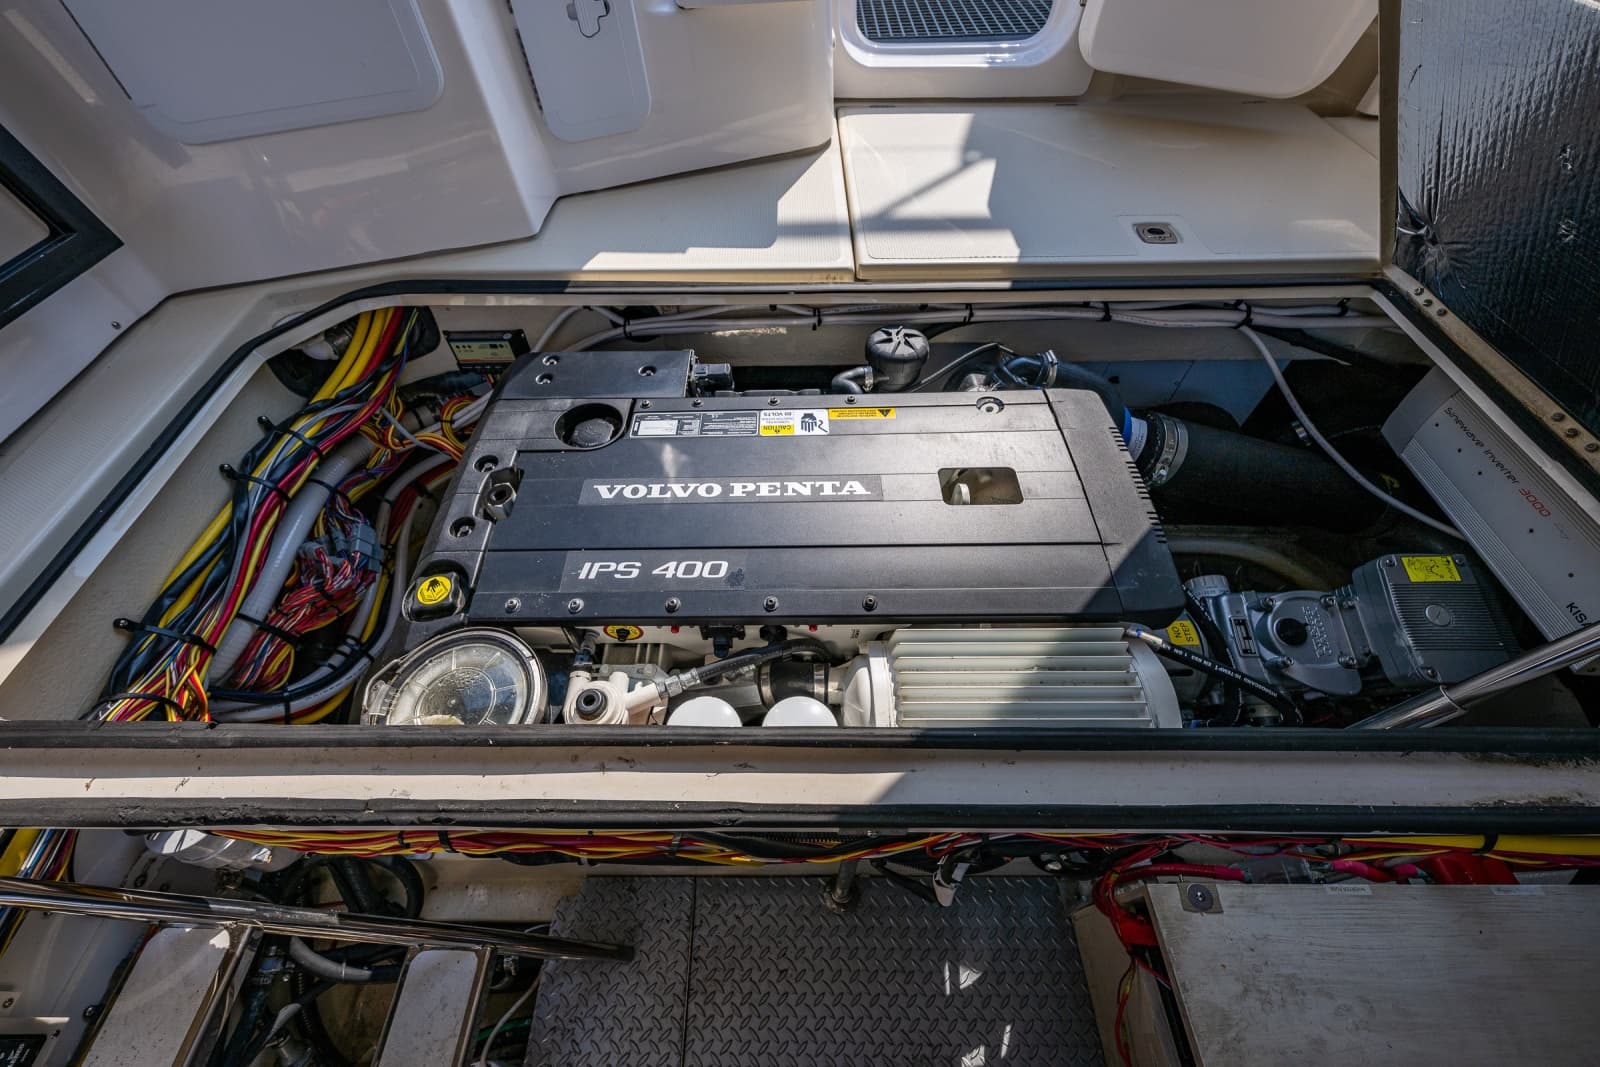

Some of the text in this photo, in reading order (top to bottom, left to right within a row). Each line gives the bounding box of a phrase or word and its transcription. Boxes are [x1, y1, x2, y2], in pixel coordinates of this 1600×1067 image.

[593, 480, 872, 499] VOLVO PENTA
[1519, 488, 1552, 518] 3000
[578, 560, 729, 579] IPS 400
[1171, 626, 1182, 638] NO
[1179, 622, 1194, 642] STEP
